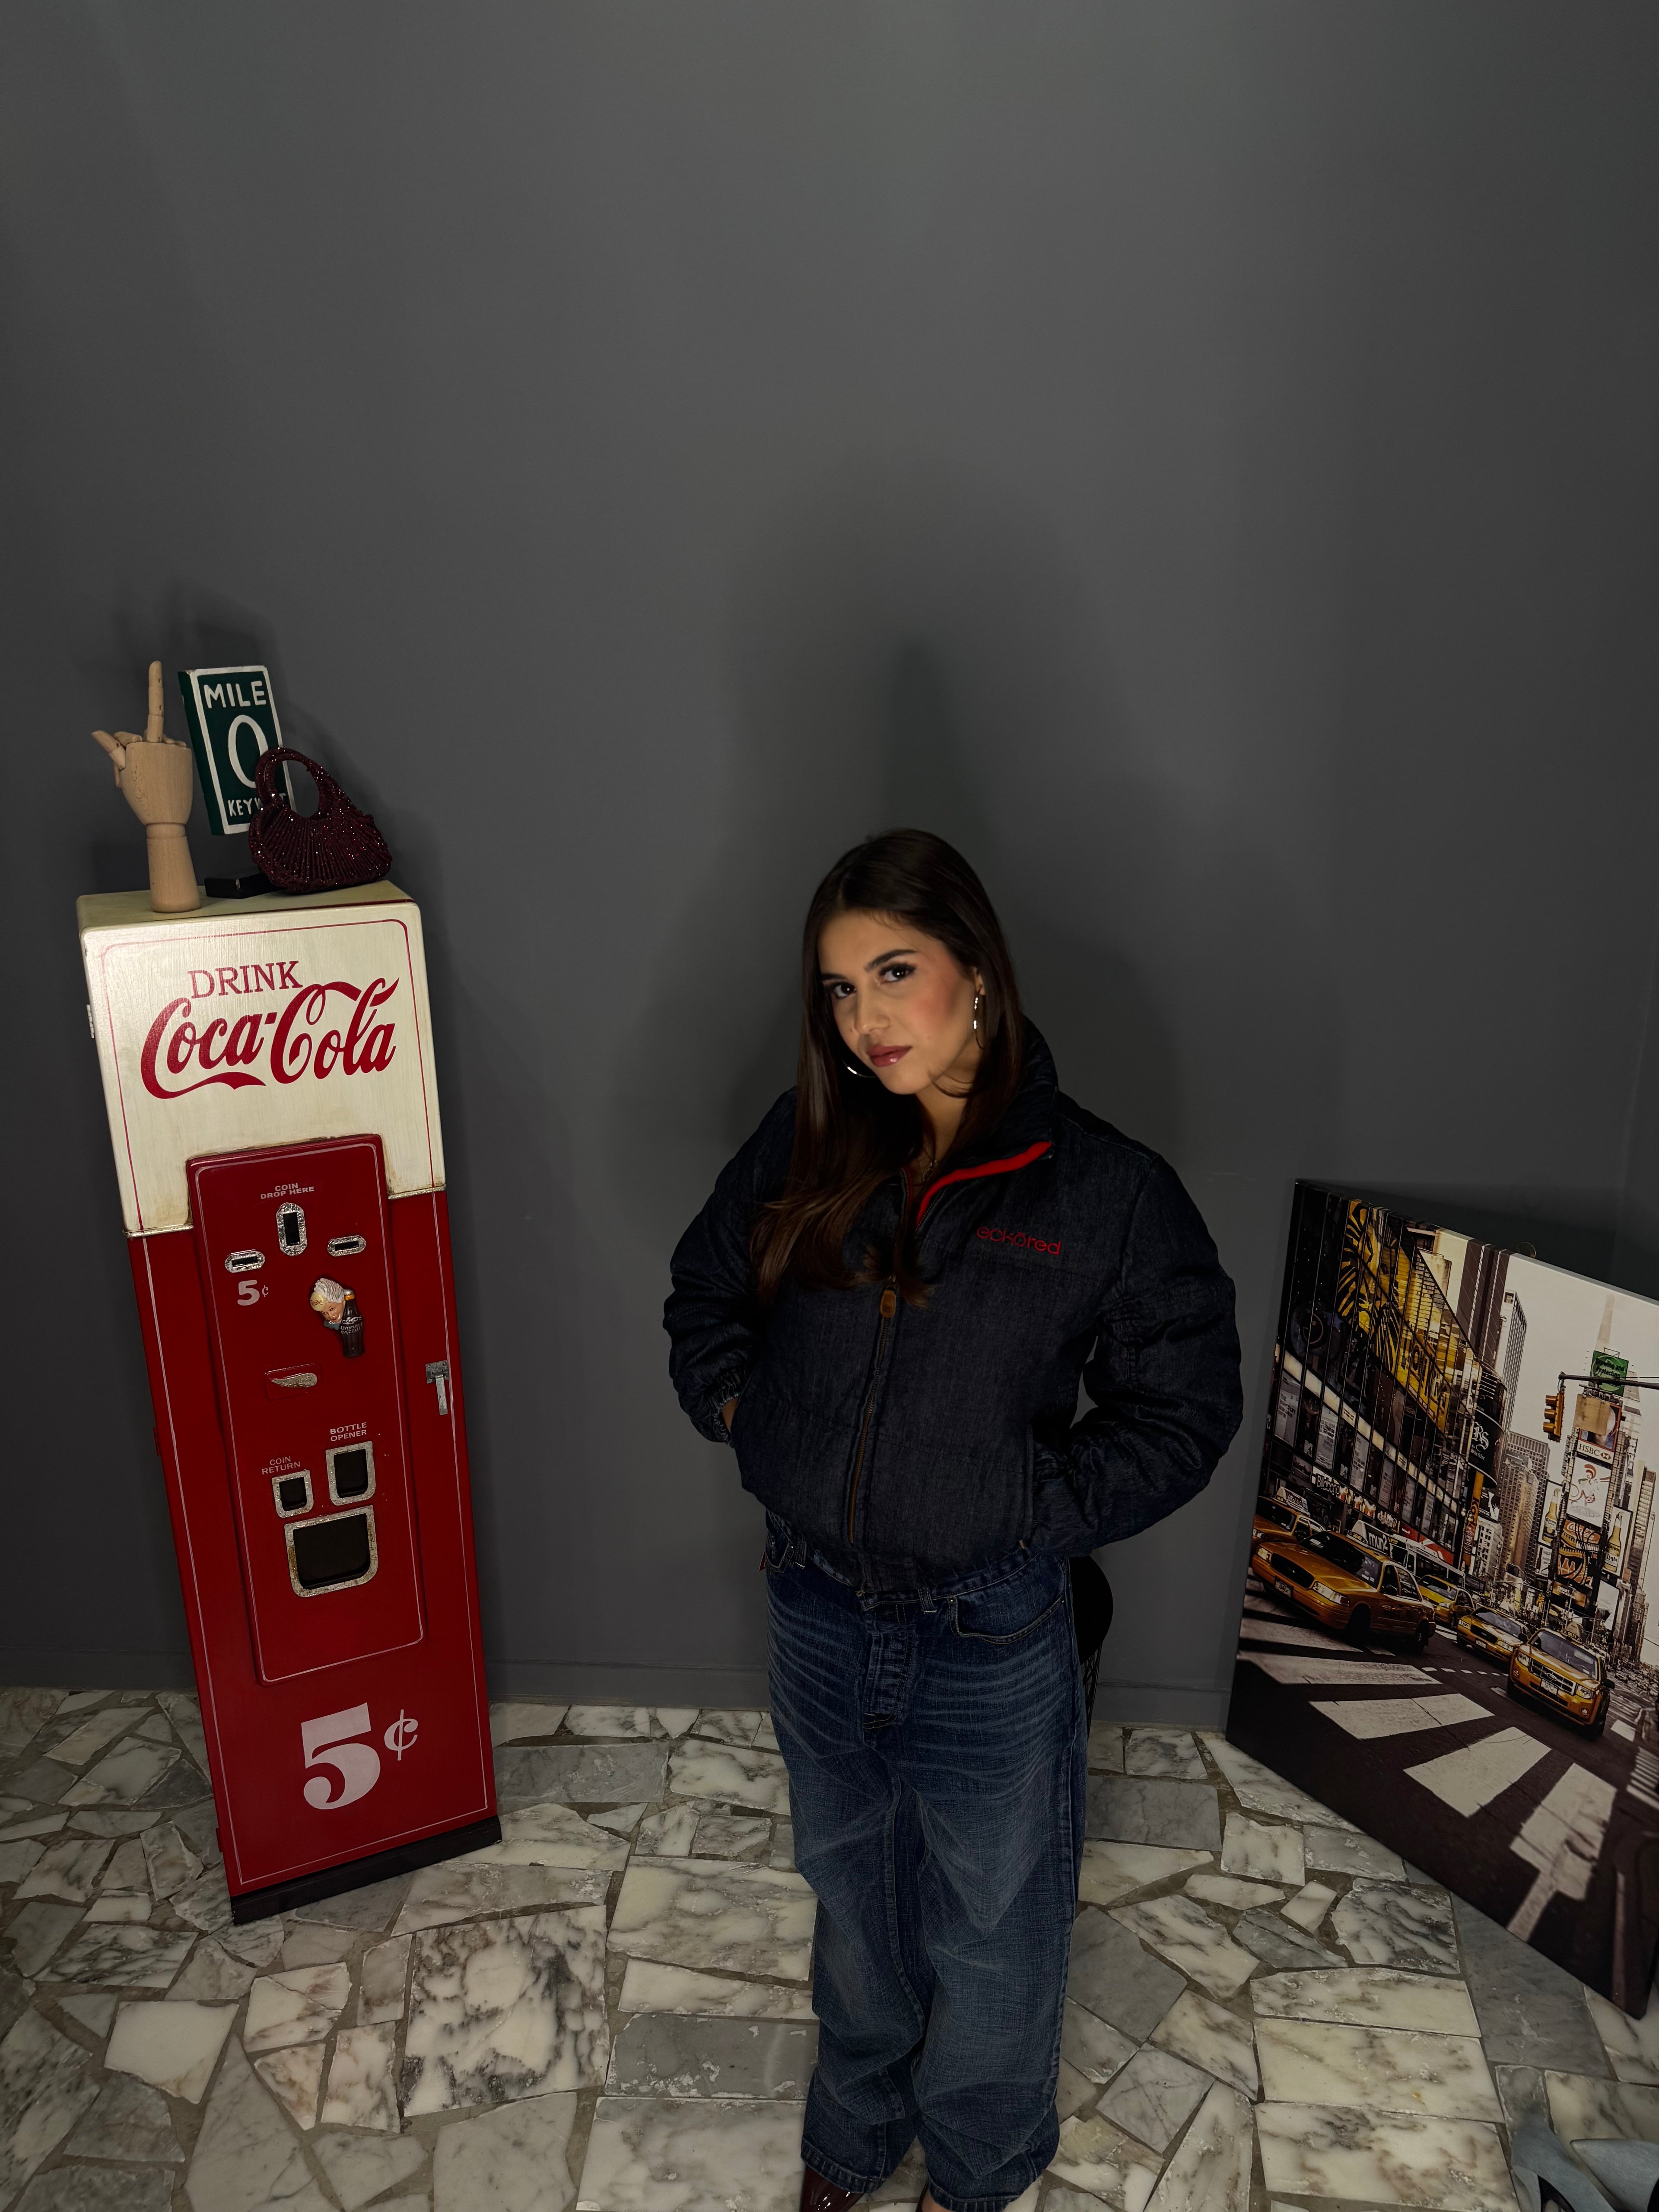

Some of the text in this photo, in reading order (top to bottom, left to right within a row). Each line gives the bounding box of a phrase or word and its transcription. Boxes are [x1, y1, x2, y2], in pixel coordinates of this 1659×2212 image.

[203, 680, 266, 709] MILE
[228, 798, 253, 817] KEY
[188, 960, 303, 999] DRINK
[140, 977, 400, 1099] Coca-Cola
[260, 1186, 315, 1199] DROP HERE
[274, 1182, 299, 1192] COIN
[330, 1422, 367, 1435] BOTTLE
[330, 1429, 367, 1442] OPENER
[1579, 1443, 1600, 1456] HSBC
[261, 1461, 301, 1475] RETURN
[269, 1456, 292, 1466] COIN
[1368, 1532, 1388, 1551] mun2
[301, 1702, 418, 1810] 5¢
